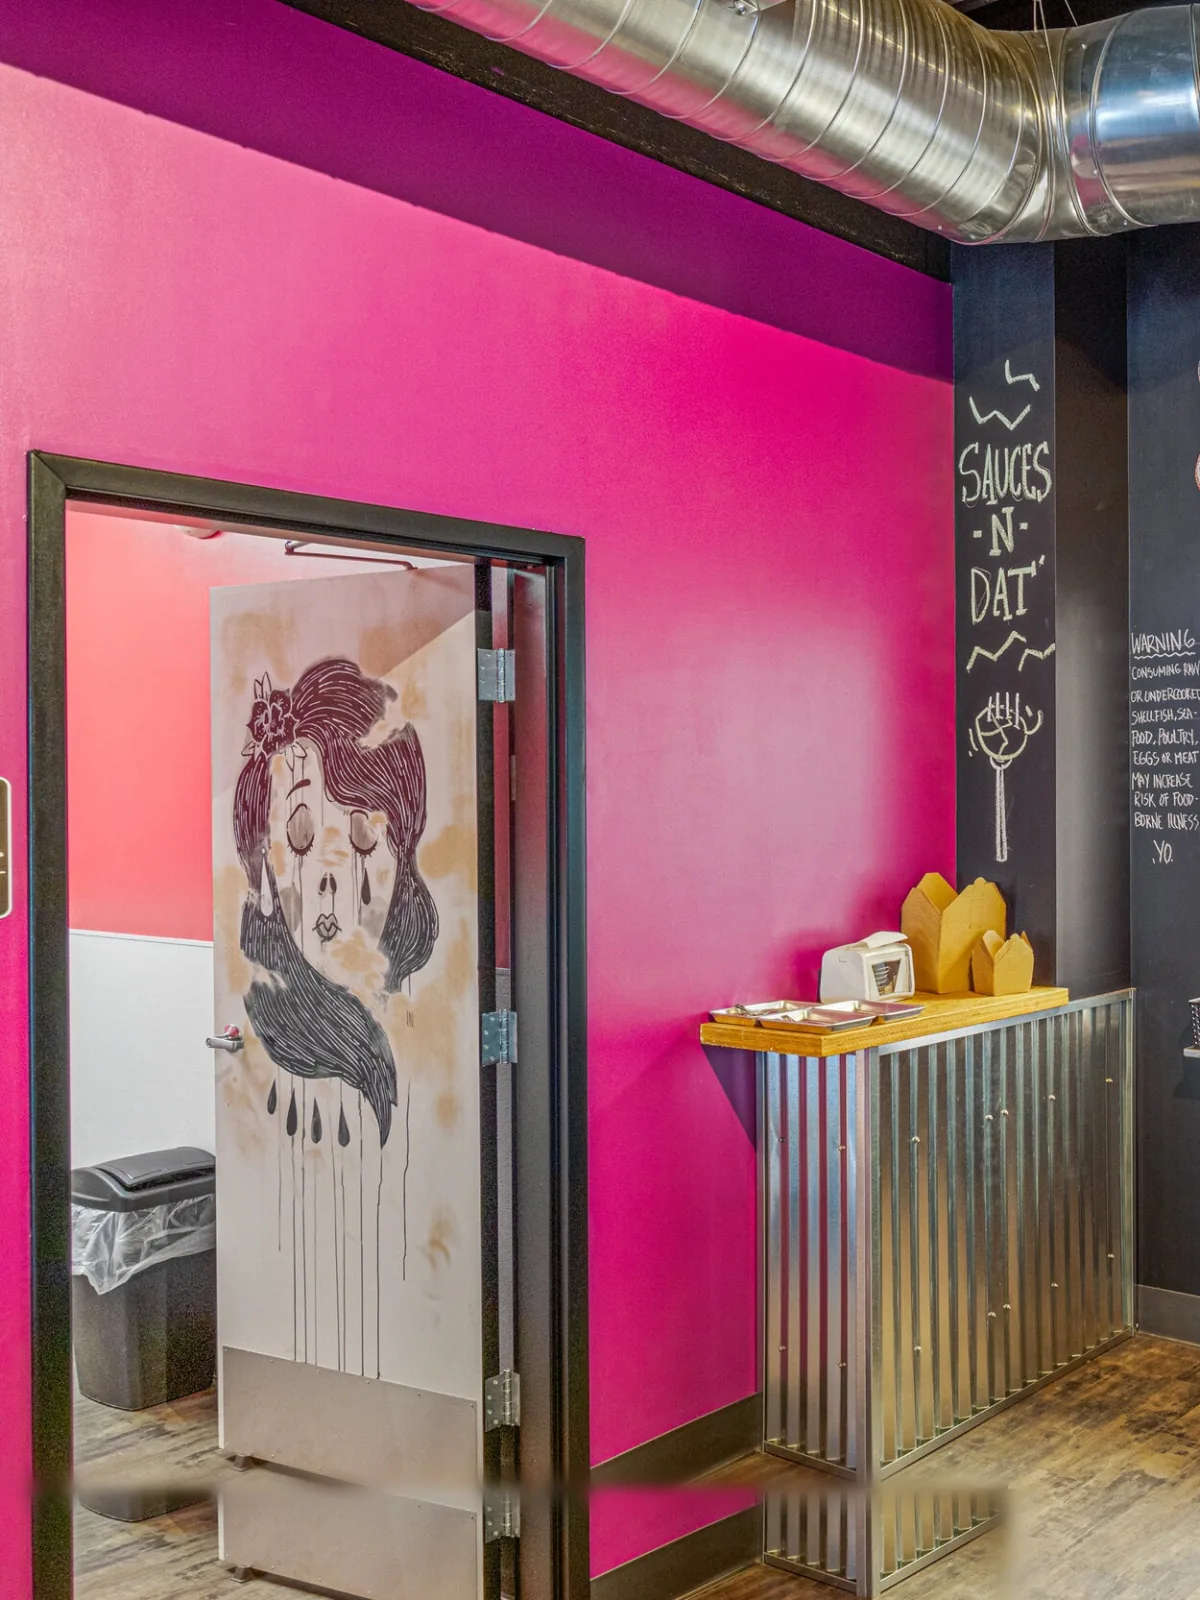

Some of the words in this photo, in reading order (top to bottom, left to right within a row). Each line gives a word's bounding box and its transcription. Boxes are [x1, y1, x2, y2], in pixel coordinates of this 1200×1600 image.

[958, 441, 1052, 507] SAUCES
[1131, 629, 1195, 654] WARNING
[1132, 663, 1181, 680] CONSUMING
[1183, 660, 1200, 676] RAW
[1130, 690, 1143, 702] OR
[1131, 709, 1177, 725] SHELLFISH,
[1133, 751, 1159, 766] EGGS
[1162, 753, 1172, 763] OR
[1174, 751, 1199, 765] MEAT
[1132, 772, 1149, 790] MAY
[1153, 772, 1193, 788] INCREASE
[1134, 791, 1156, 807] RISK
[1159, 793, 1169, 806] OF
[1134, 812, 1163, 829] BORNE
[1168, 813, 1199, 830] ILLNESS
